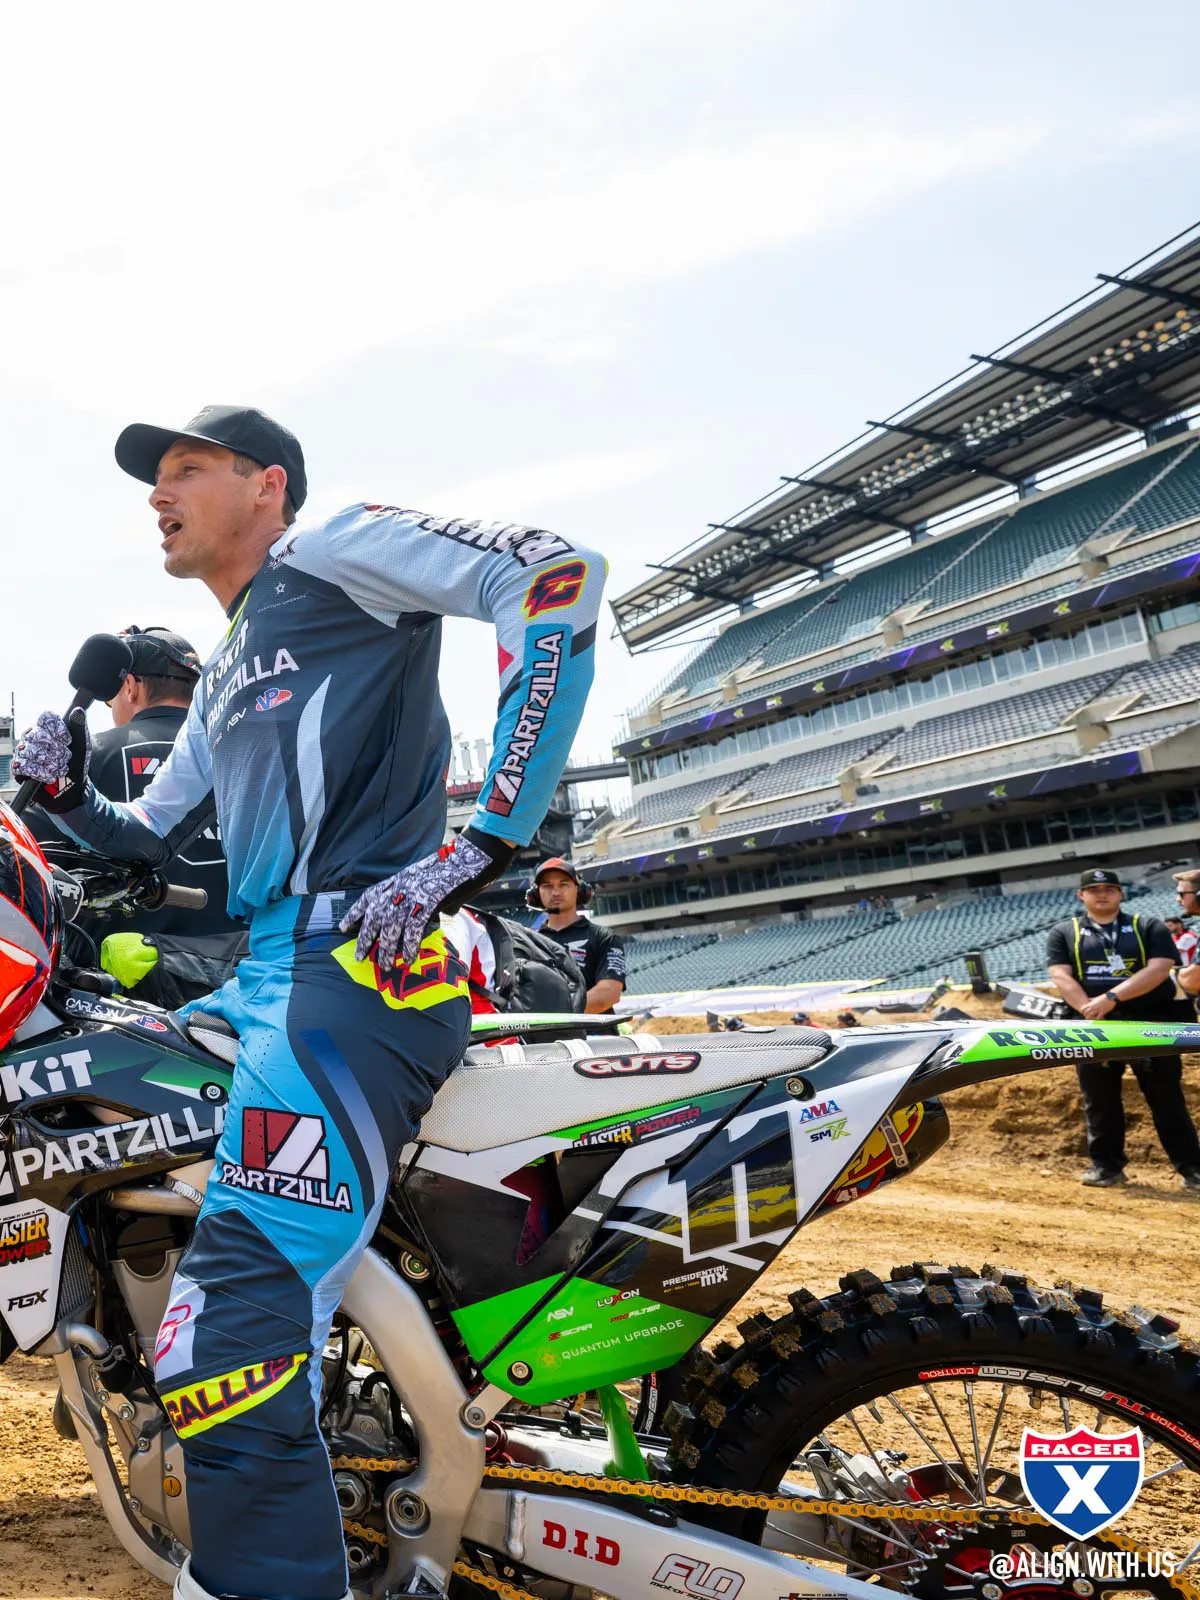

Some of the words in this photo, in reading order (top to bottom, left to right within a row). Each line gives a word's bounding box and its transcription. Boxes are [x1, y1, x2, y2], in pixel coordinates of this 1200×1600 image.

[502, 630, 565, 775] PARTZILLA
[500, 1023, 530, 1031] OXYGEN
[579, 1053, 698, 1075] GUTS
[1031, 1047, 1095, 1061] OXYGEN
[634, 1106, 701, 1139] POWER
[799, 1100, 841, 1124] AMA
[810, 1119, 851, 1143] SMX
[221, 1163, 352, 1213] PARTZILLA
[662, 1265, 728, 1287] PRESIDENTIAL
[7, 1288, 49, 1312] FGX
[596, 1288, 640, 1308] LUXON
[561, 1336, 621, 1360] QUANTUM
[624, 1319, 685, 1342] UPGRADE
